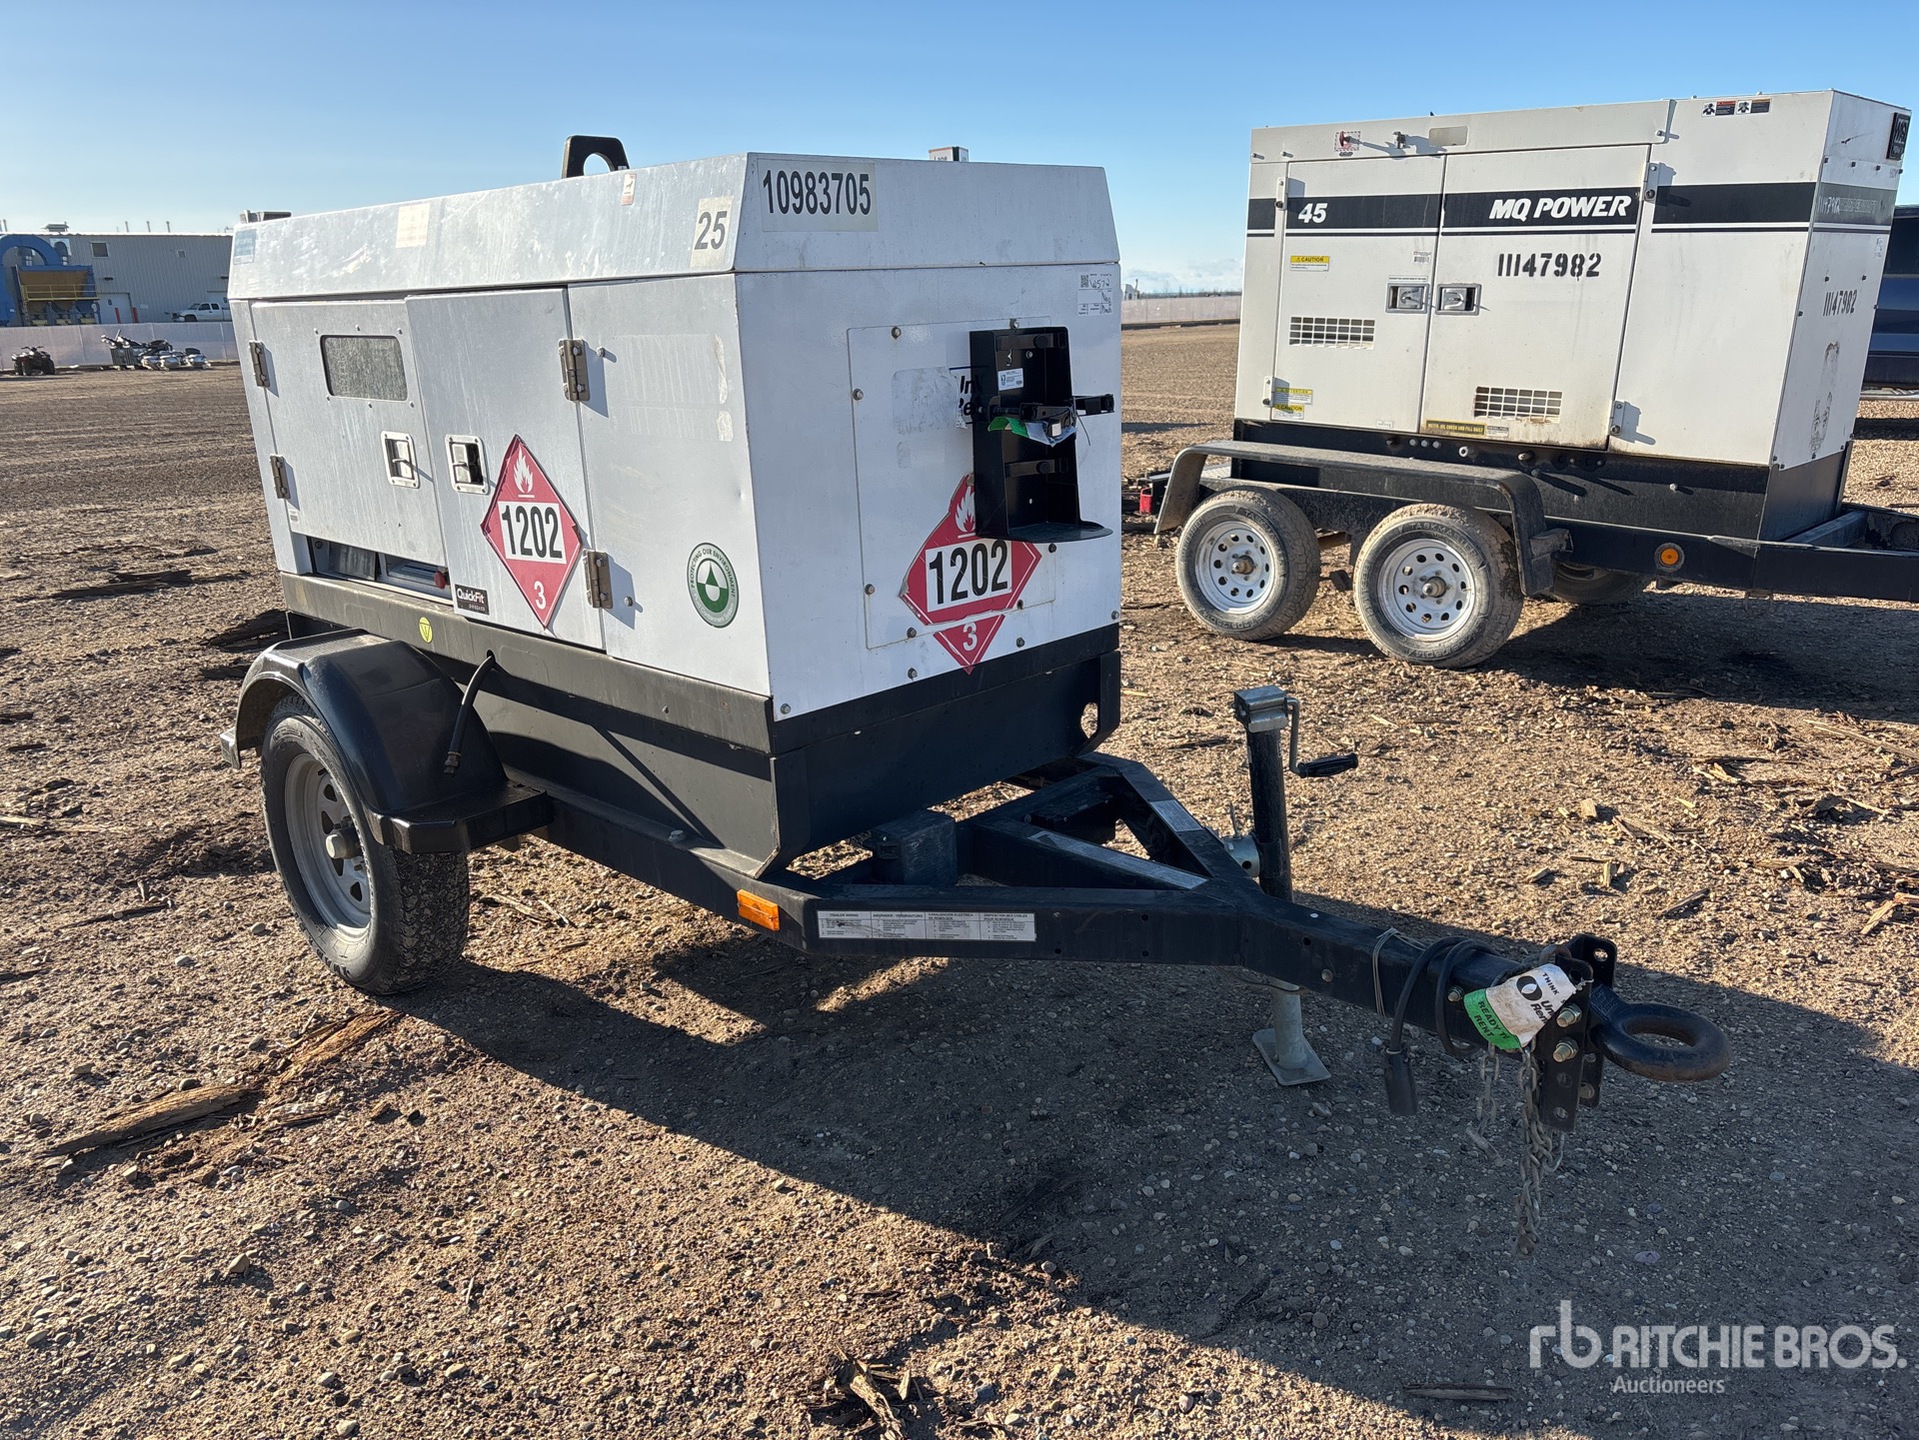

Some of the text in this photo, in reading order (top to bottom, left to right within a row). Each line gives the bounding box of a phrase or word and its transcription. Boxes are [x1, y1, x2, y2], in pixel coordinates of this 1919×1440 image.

[763, 170, 871, 215] 10983705
[1298, 203, 1328, 224] 45
[1489, 195, 1632, 222] MQ POWER
[694, 210, 728, 250] 25
[501, 505, 563, 559] 1202
[689, 549, 703, 588] PROTECTING
[713, 550, 736, 598] ENVIRONMENT
[929, 540, 1008, 605] 1202
[457, 588, 485, 604] QuickFit
[533, 580, 547, 609] 3
[962, 622, 978, 651] 3
[1542, 972, 1560, 996] THINK
[1474, 1014, 1495, 1037] RENT
[1478, 1001, 1500, 1030] READY
